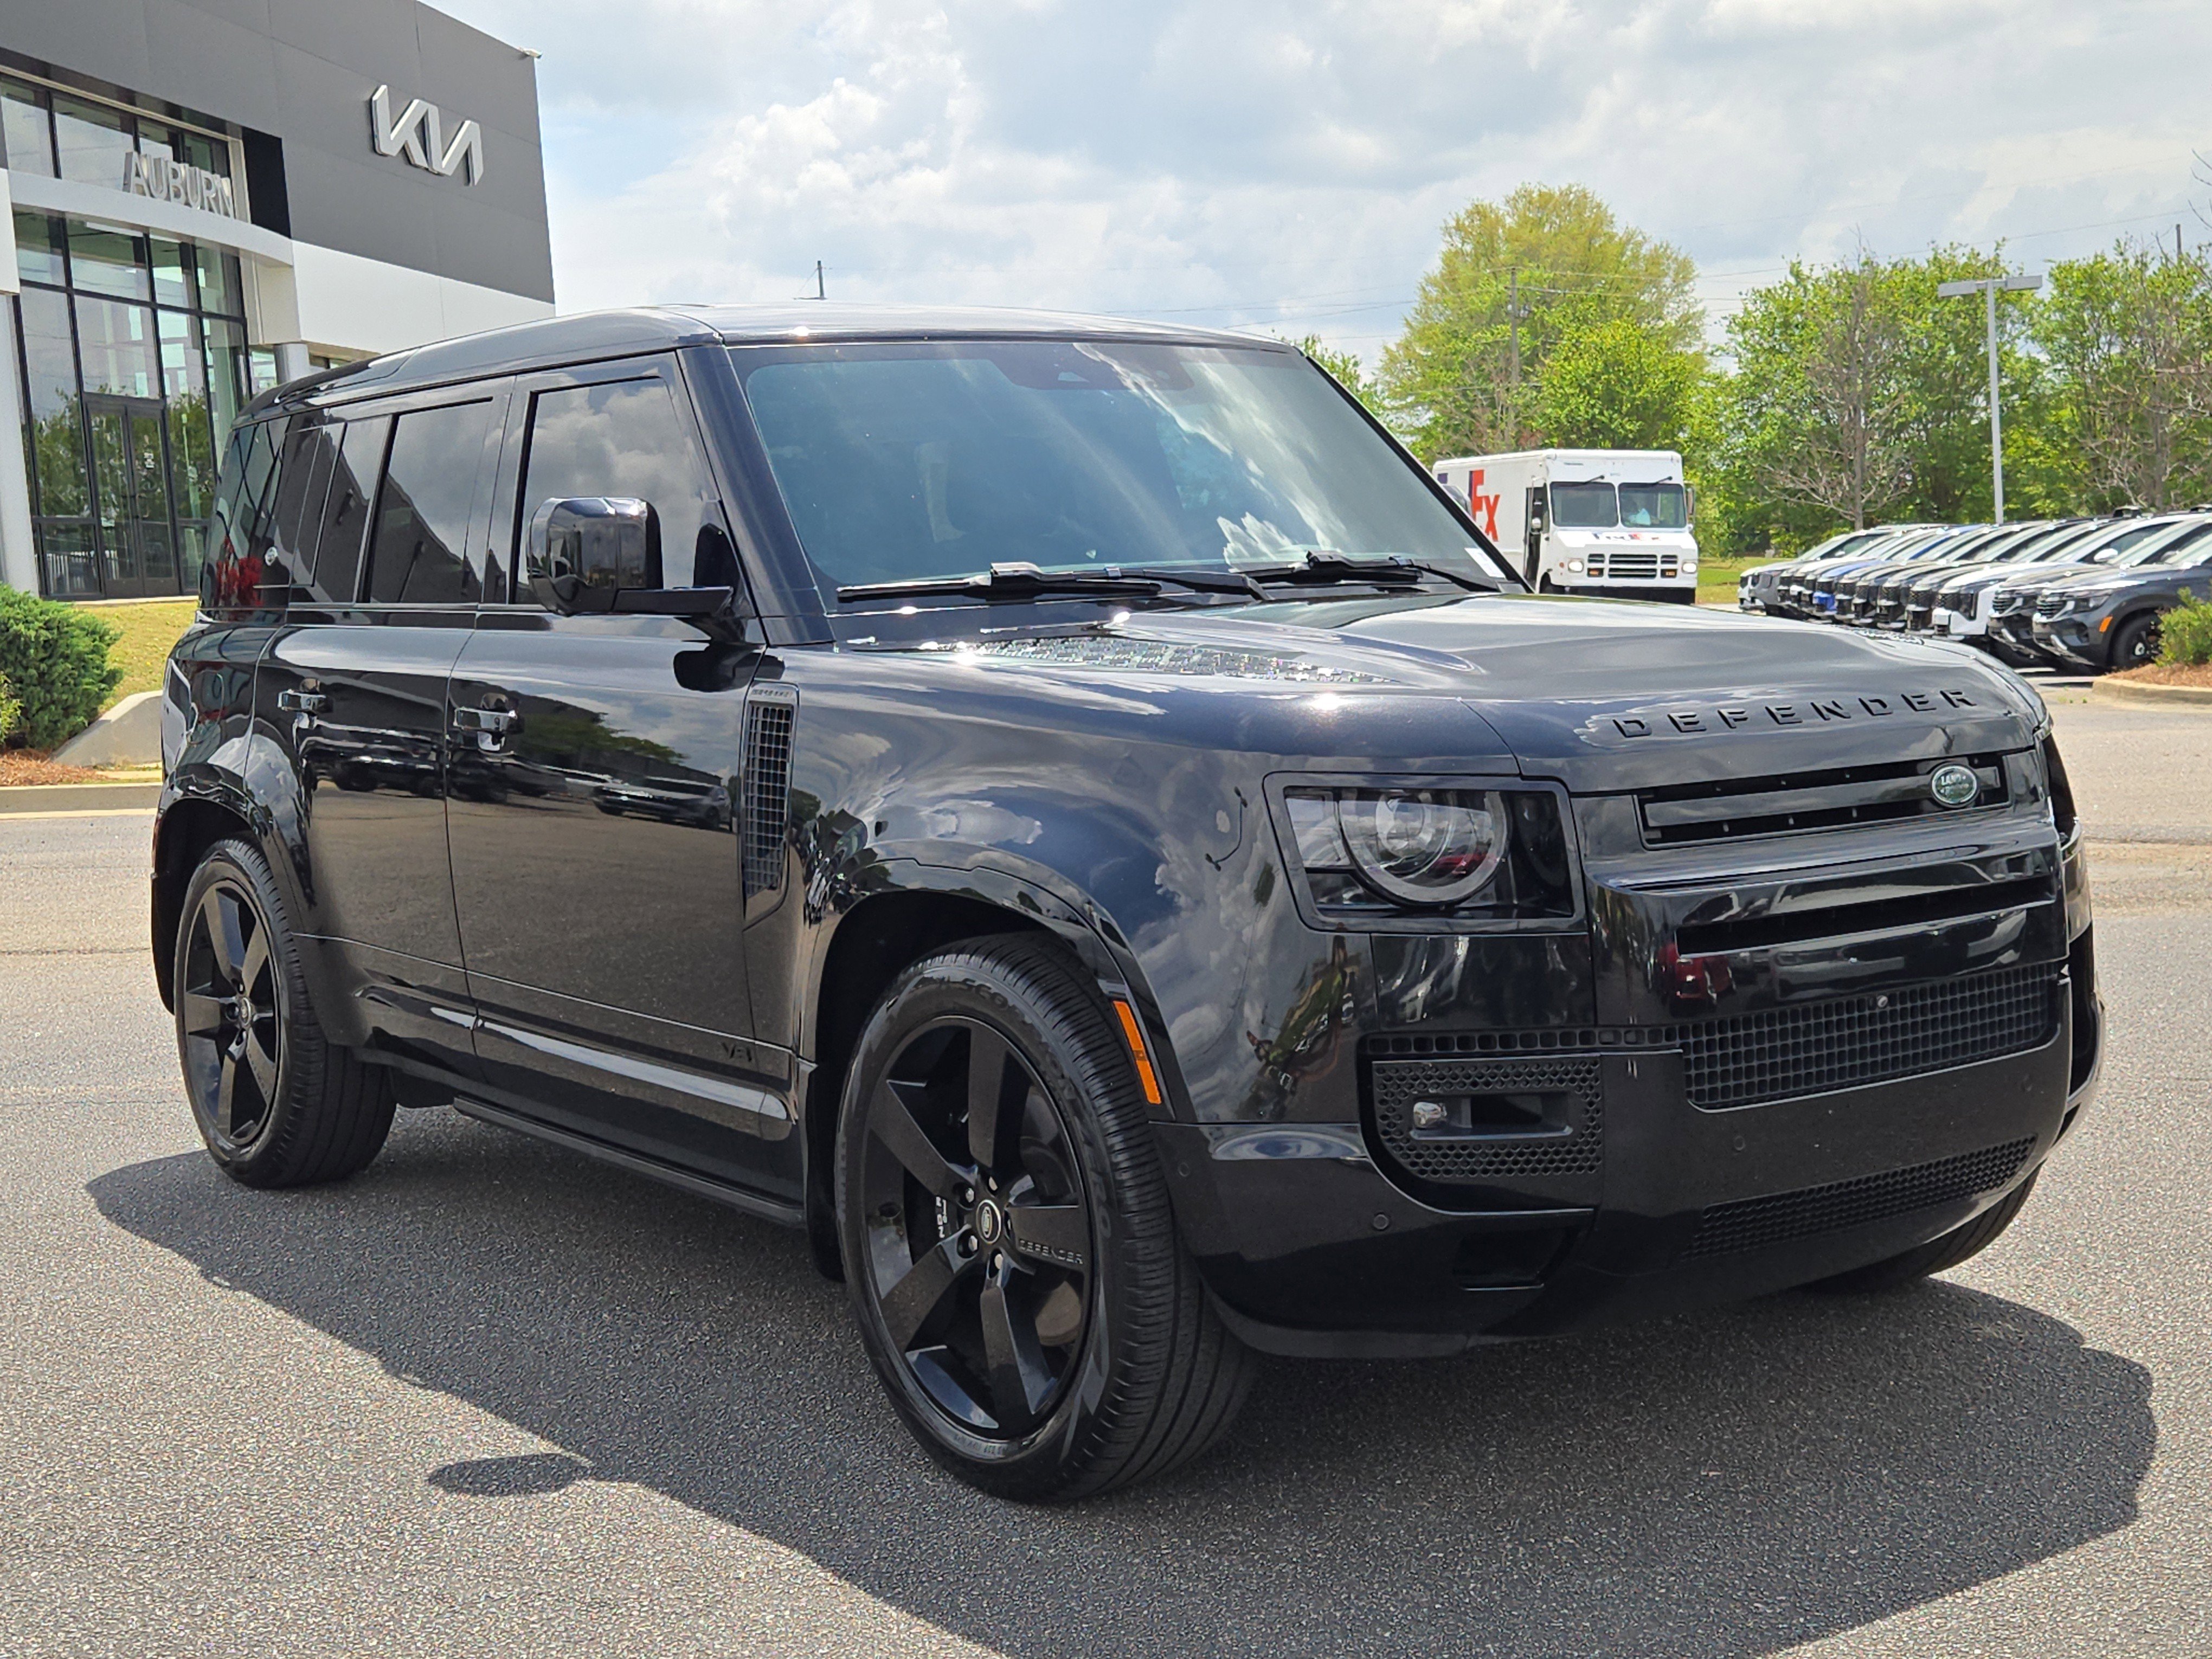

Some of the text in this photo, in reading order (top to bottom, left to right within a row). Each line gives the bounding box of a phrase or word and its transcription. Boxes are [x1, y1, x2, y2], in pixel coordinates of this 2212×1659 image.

[123, 151, 235, 218] AUBURN
[1612, 689, 1977, 738] DEFENDER
[1019, 1238, 1083, 1264] DEFENDER
